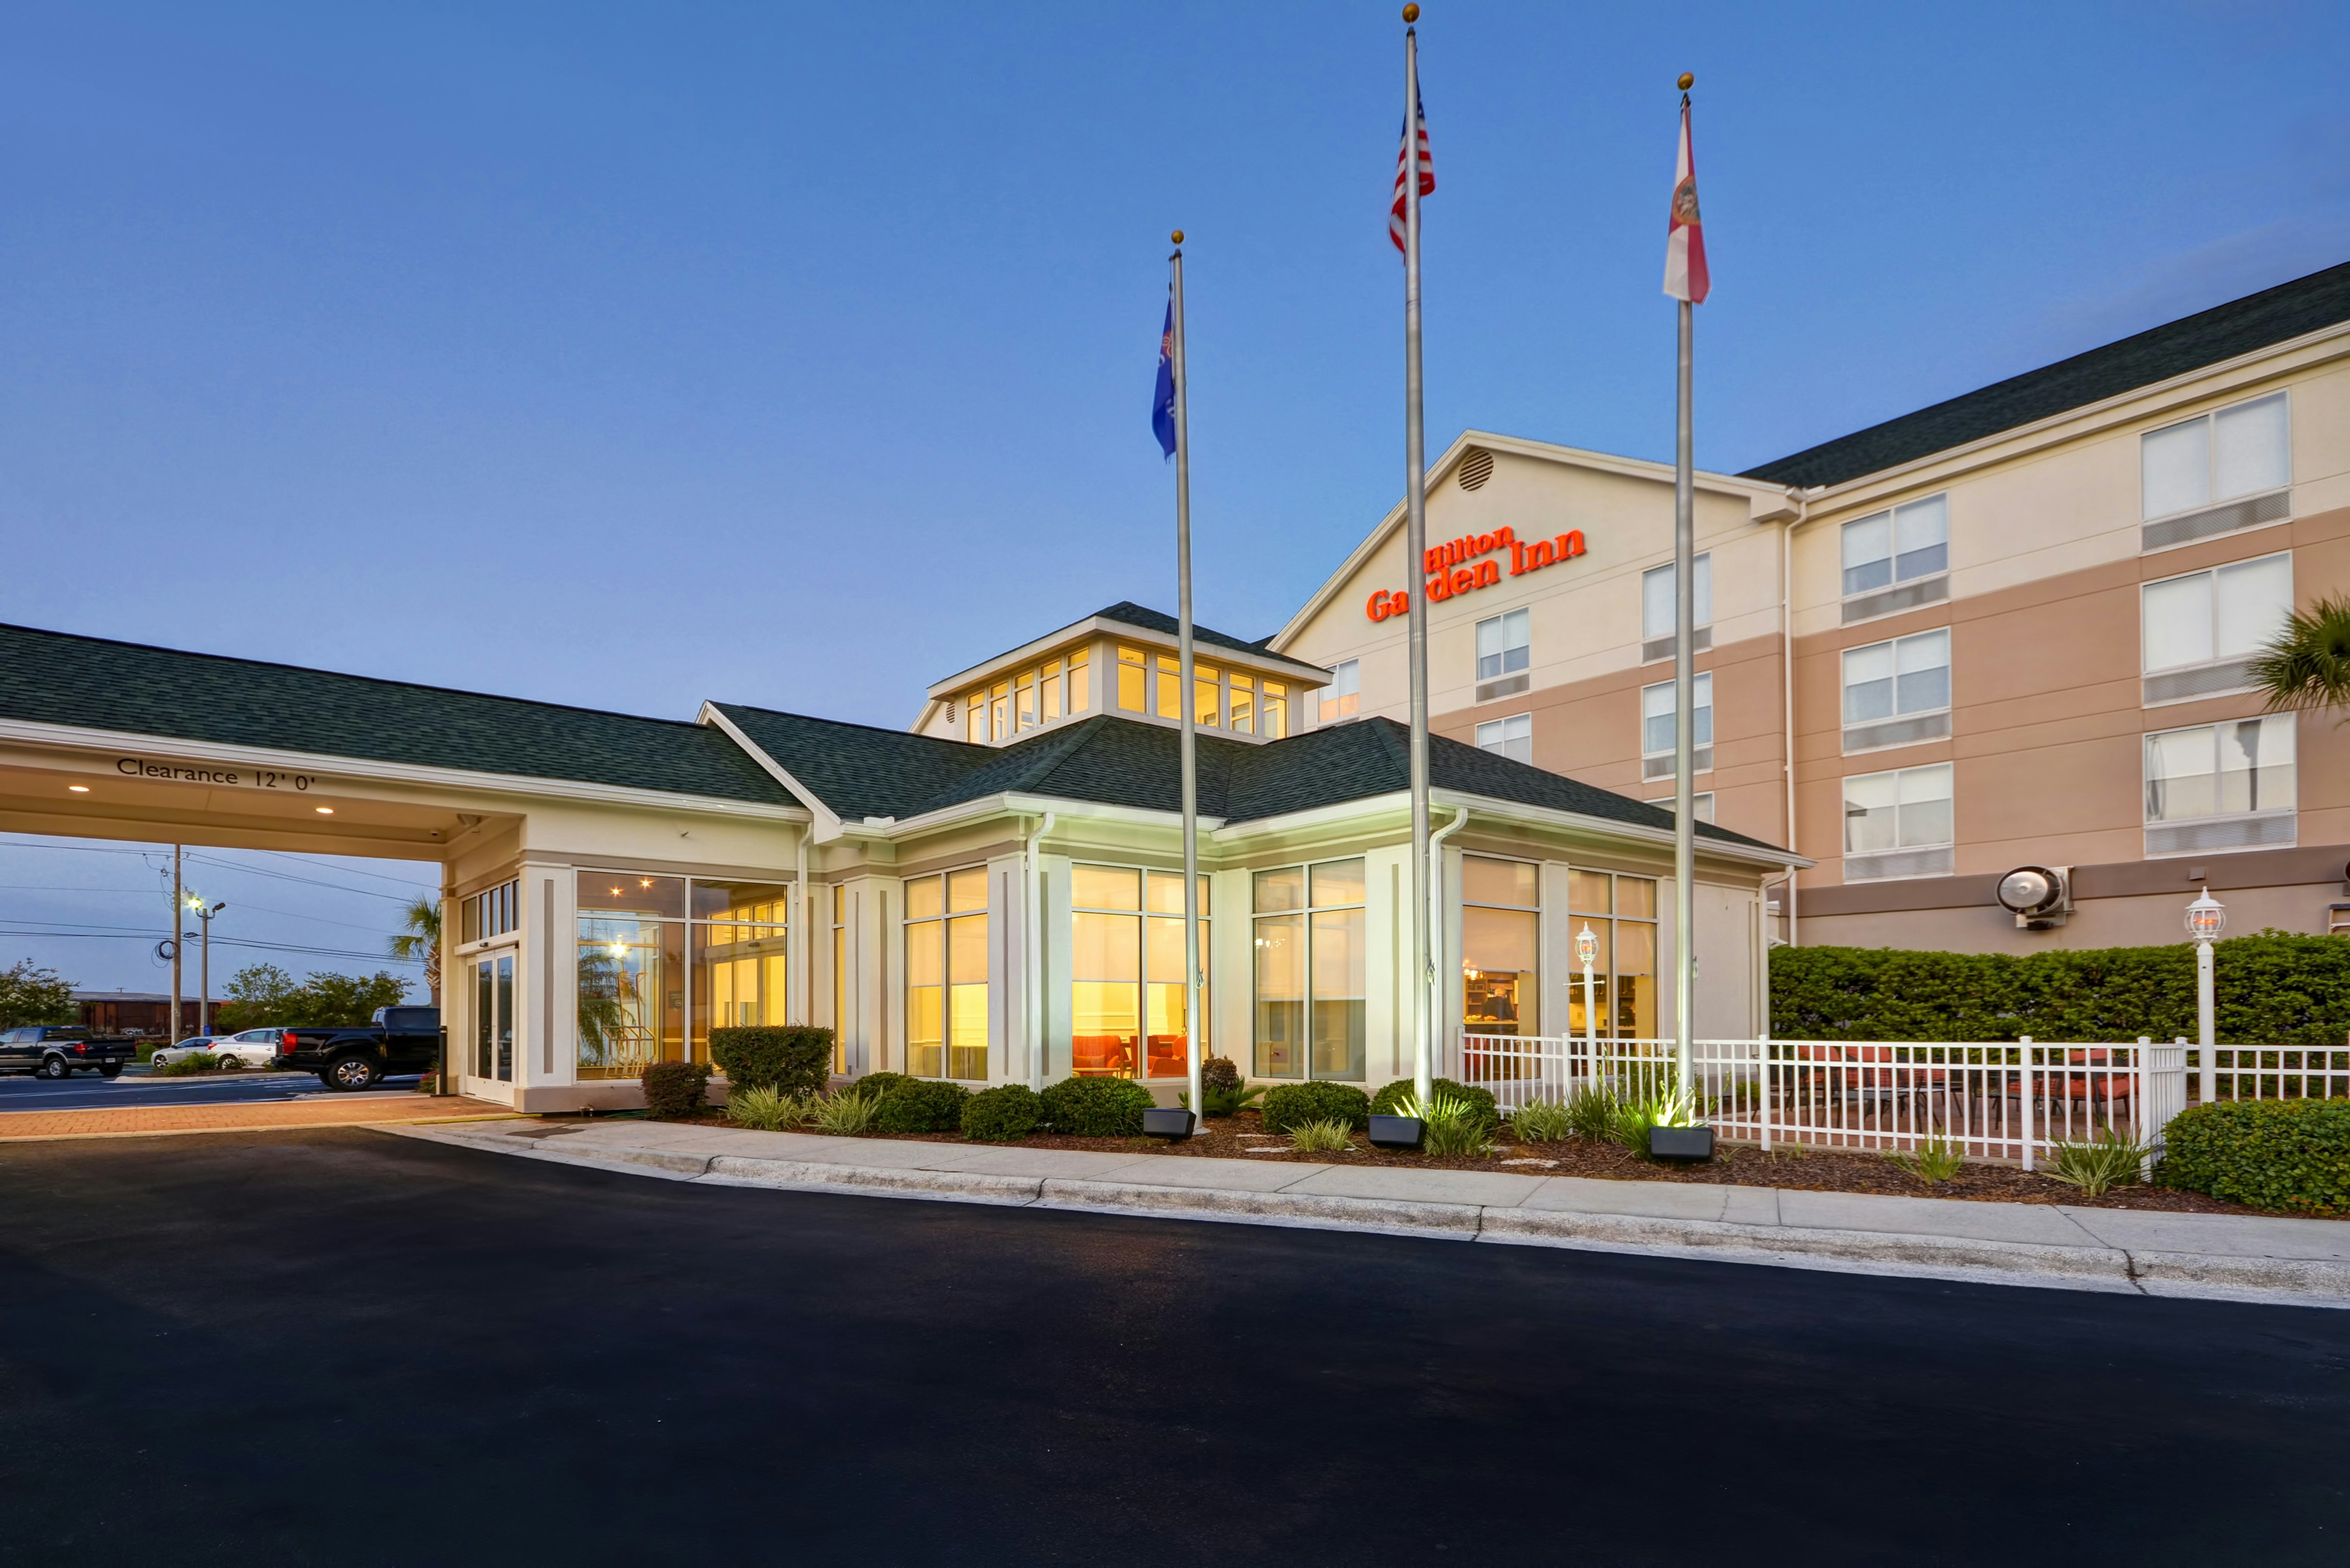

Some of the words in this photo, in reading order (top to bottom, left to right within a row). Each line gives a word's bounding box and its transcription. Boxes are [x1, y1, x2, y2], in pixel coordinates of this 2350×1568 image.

[1424, 525, 1515, 573] Hilton
[1366, 559, 1500, 622] Gaden
[1509, 529, 1586, 576] Inn
[116, 758, 239, 785] Clearance
[256, 771, 286, 788] 12'
